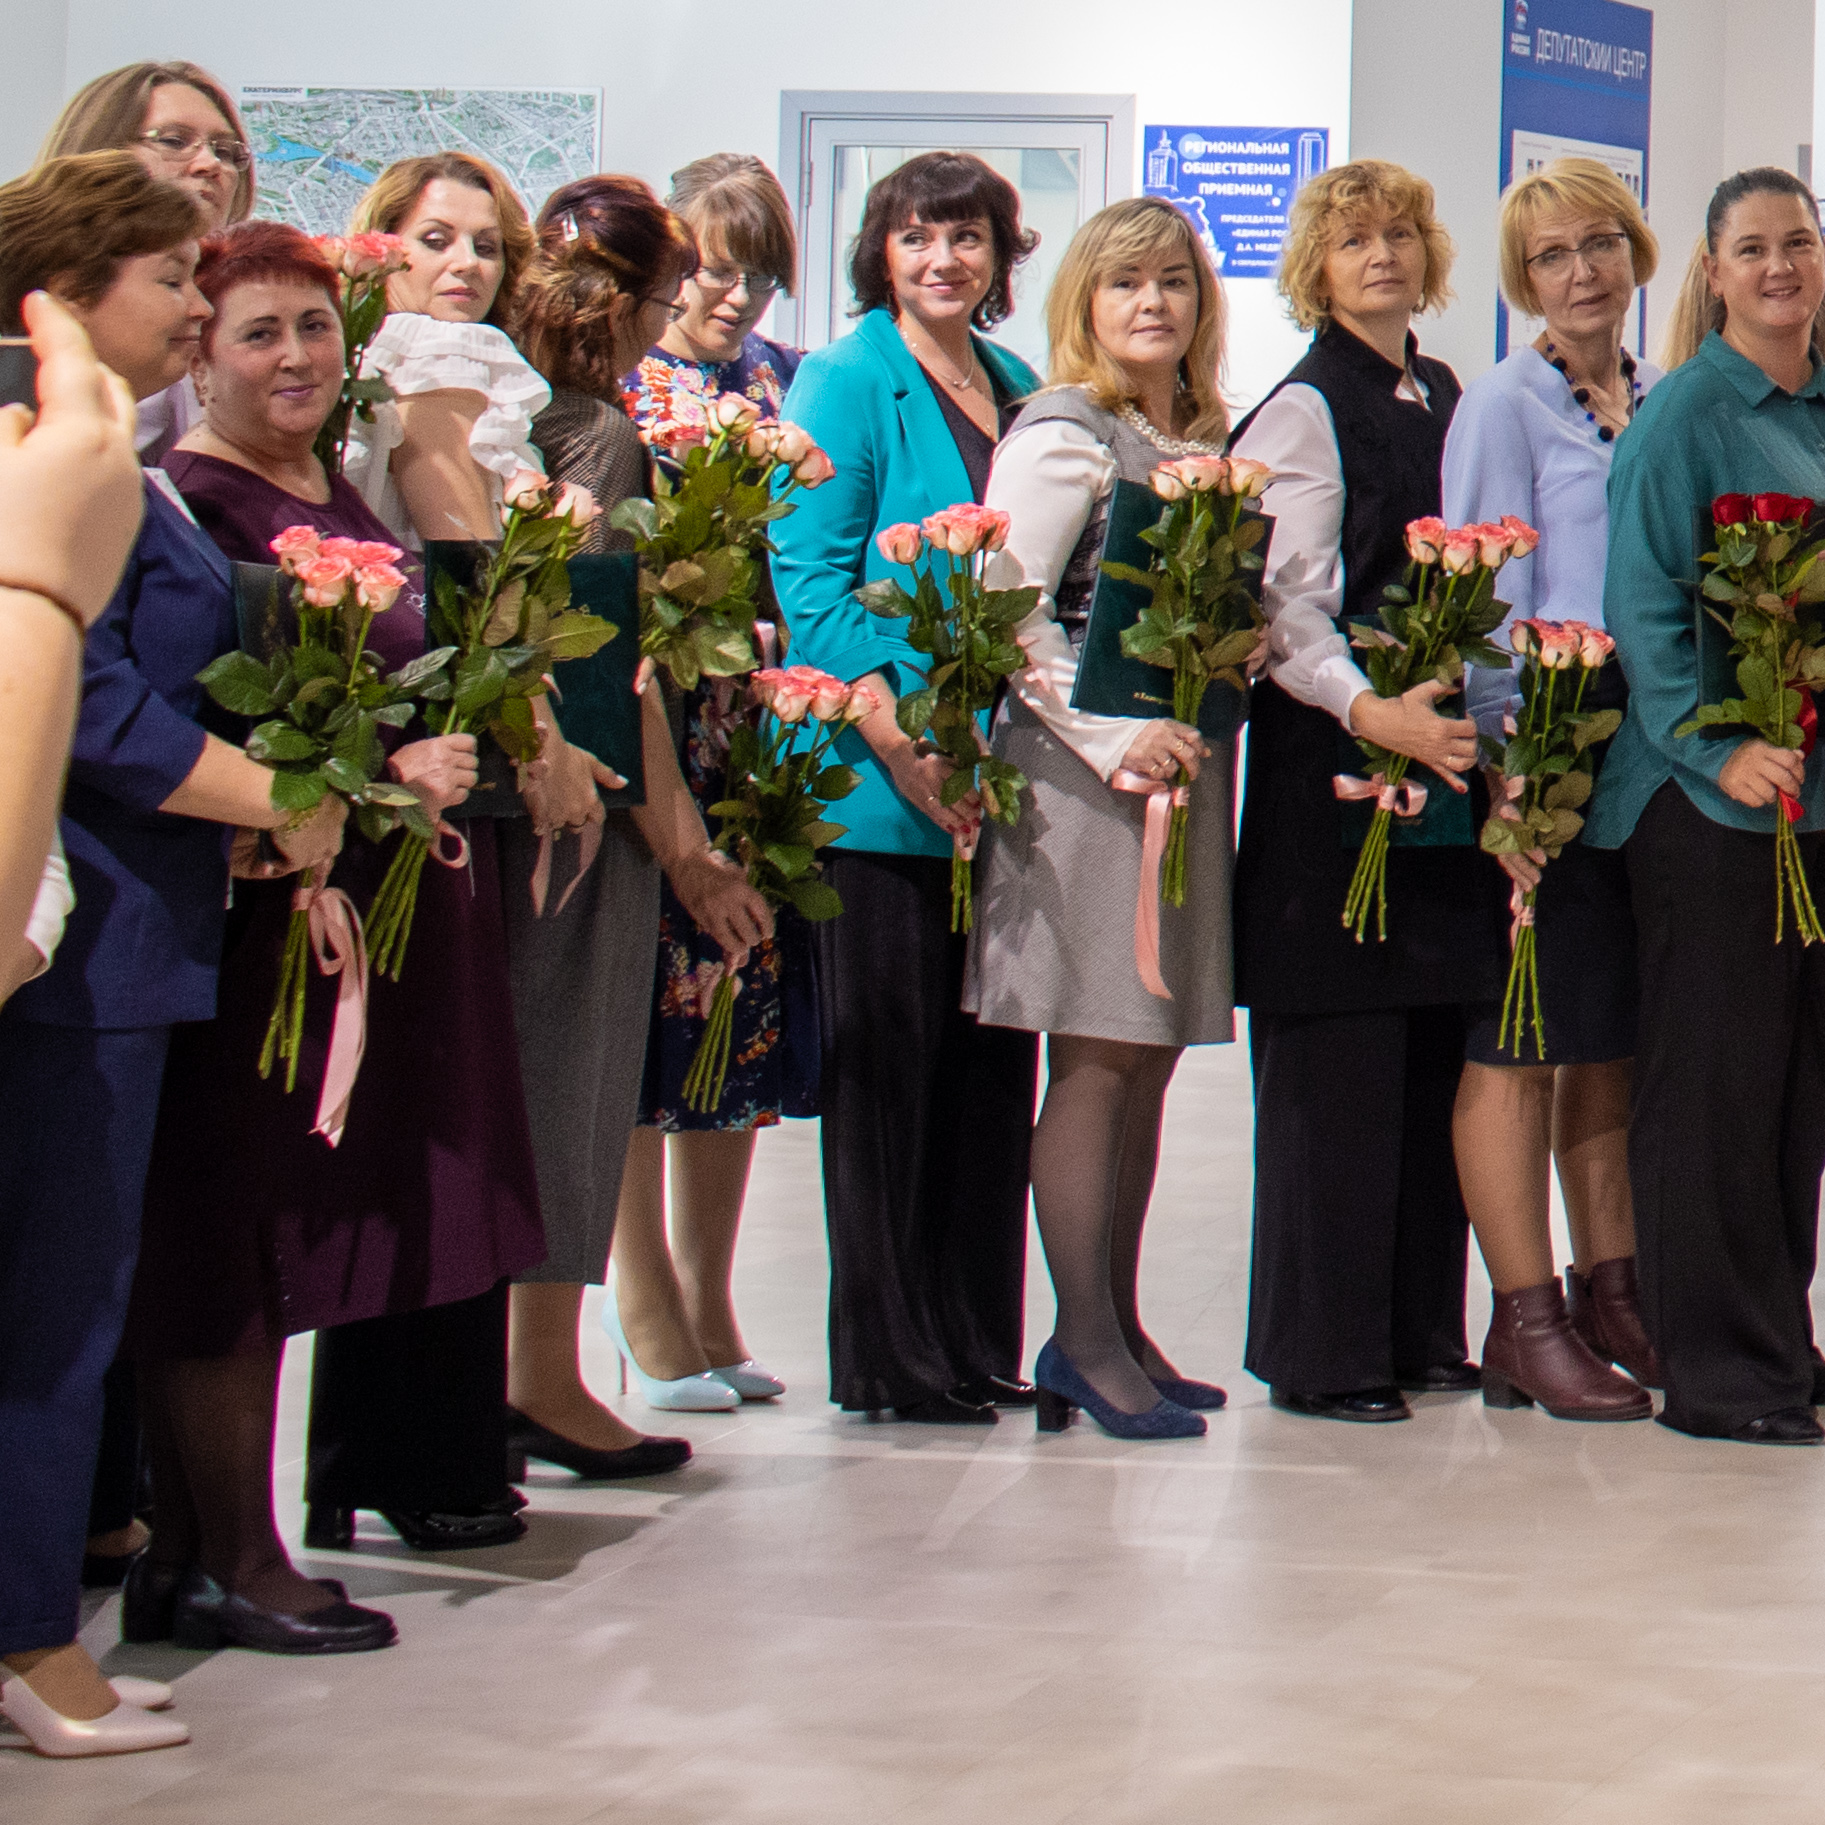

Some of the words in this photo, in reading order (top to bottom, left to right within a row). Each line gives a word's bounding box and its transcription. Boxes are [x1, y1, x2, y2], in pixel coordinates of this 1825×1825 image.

[1613, 45, 1648, 83] ЦЕНТР
[1184, 141, 1290, 155] РЕГИОНАЛЬНАЯ
[1182, 161, 1291, 176] ОБЩЕСТВЕННАЯ
[1199, 182, 1273, 196] ПРИЕМНАЯ
